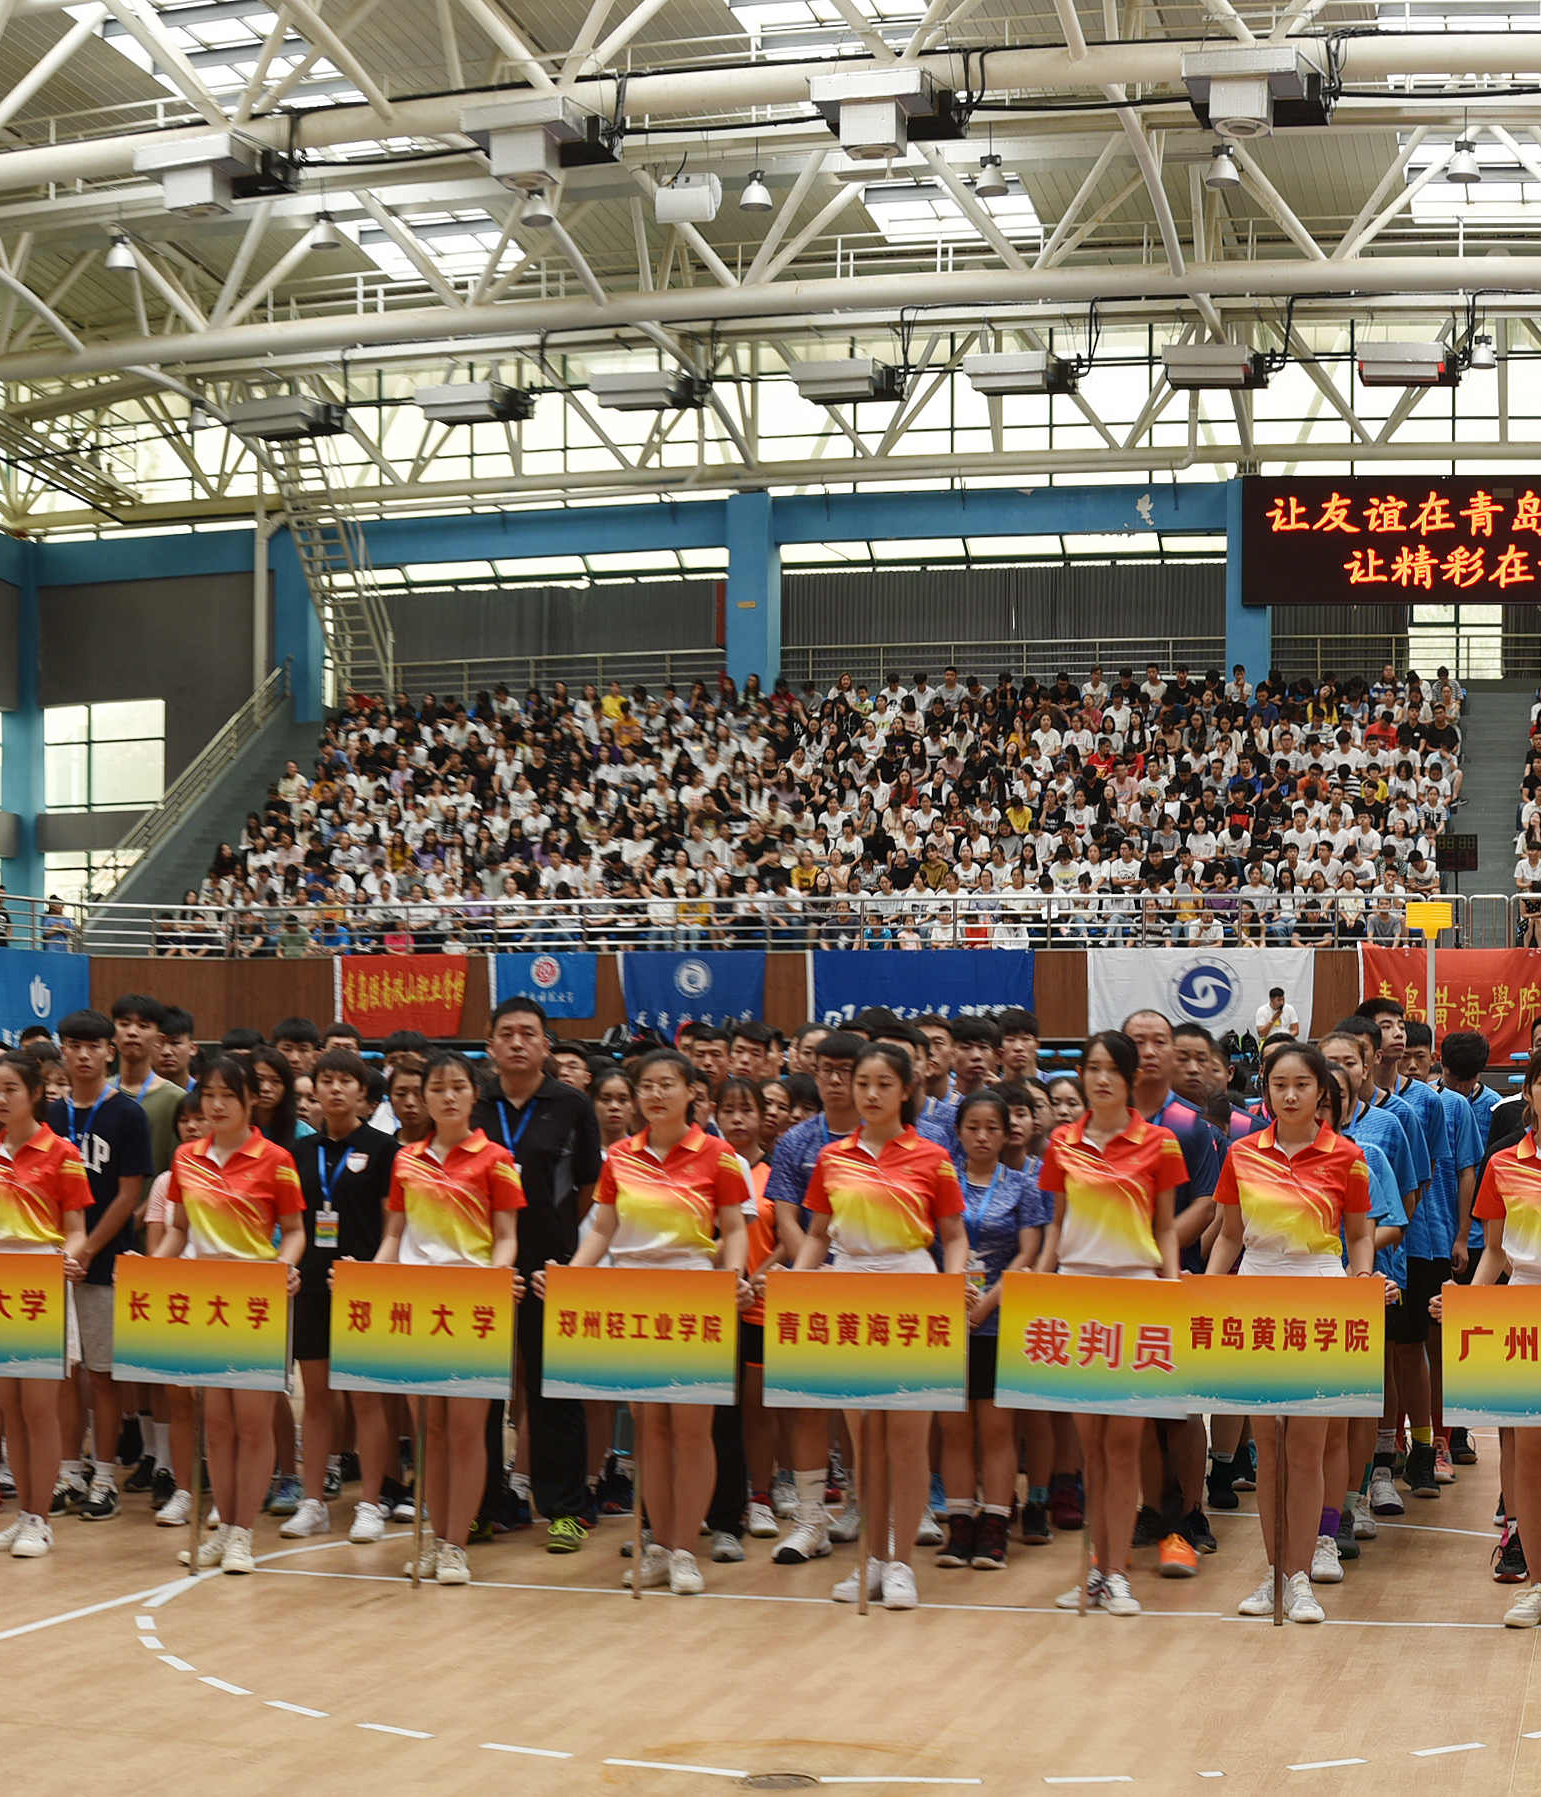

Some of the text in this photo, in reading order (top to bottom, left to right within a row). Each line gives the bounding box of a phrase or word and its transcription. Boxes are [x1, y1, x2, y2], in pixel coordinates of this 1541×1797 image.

[128, 1290, 270, 1330] 长安大学
[348, 1299, 496, 1340] 郑州大学
[559, 1309, 722, 1344] 郑州轻工业学院
[777, 1311, 951, 1348] 青岛黄海学院
[1024, 1318, 1175, 1373] 裁判员
[1189, 1315, 1370, 1353] 青岛黄海学院
